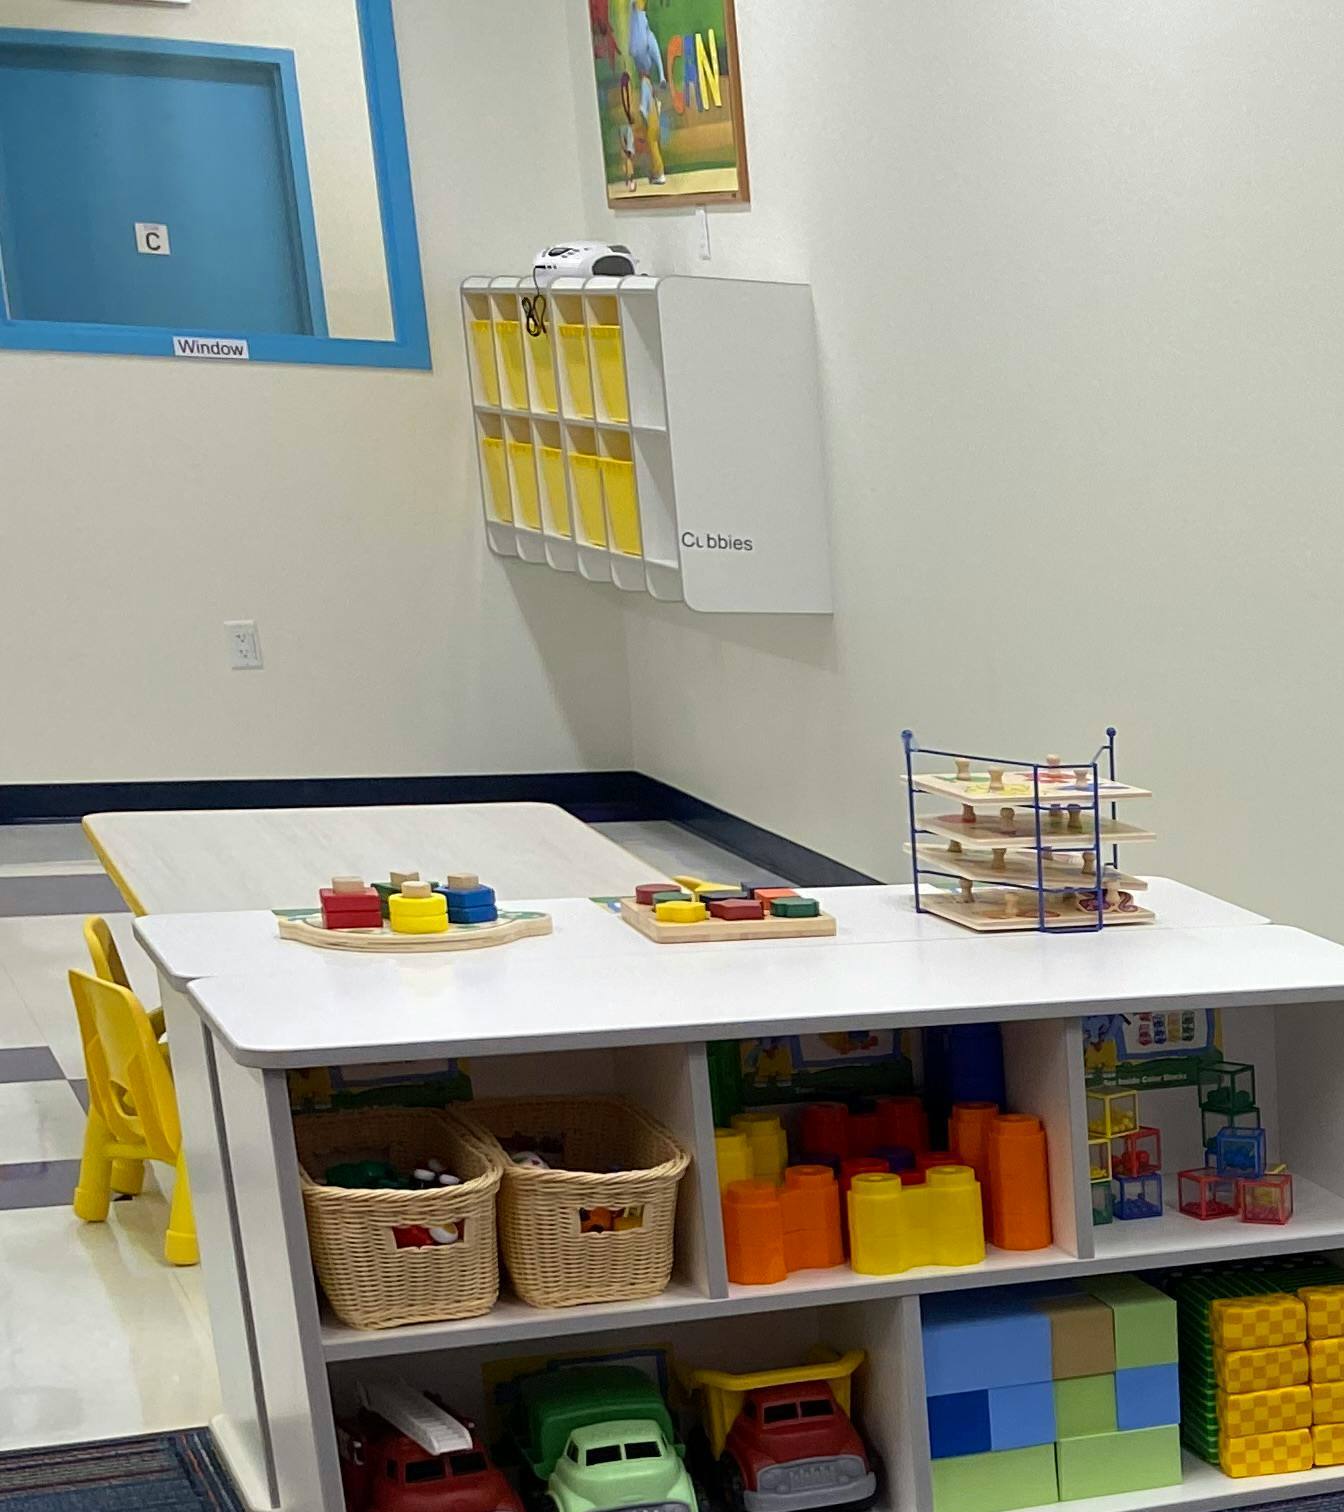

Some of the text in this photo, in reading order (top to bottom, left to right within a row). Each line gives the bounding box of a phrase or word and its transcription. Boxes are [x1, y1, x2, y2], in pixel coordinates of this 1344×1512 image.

[667, 28, 723, 115] CAN
[145, 232, 161, 251] C
[177, 339, 244, 356] Window
